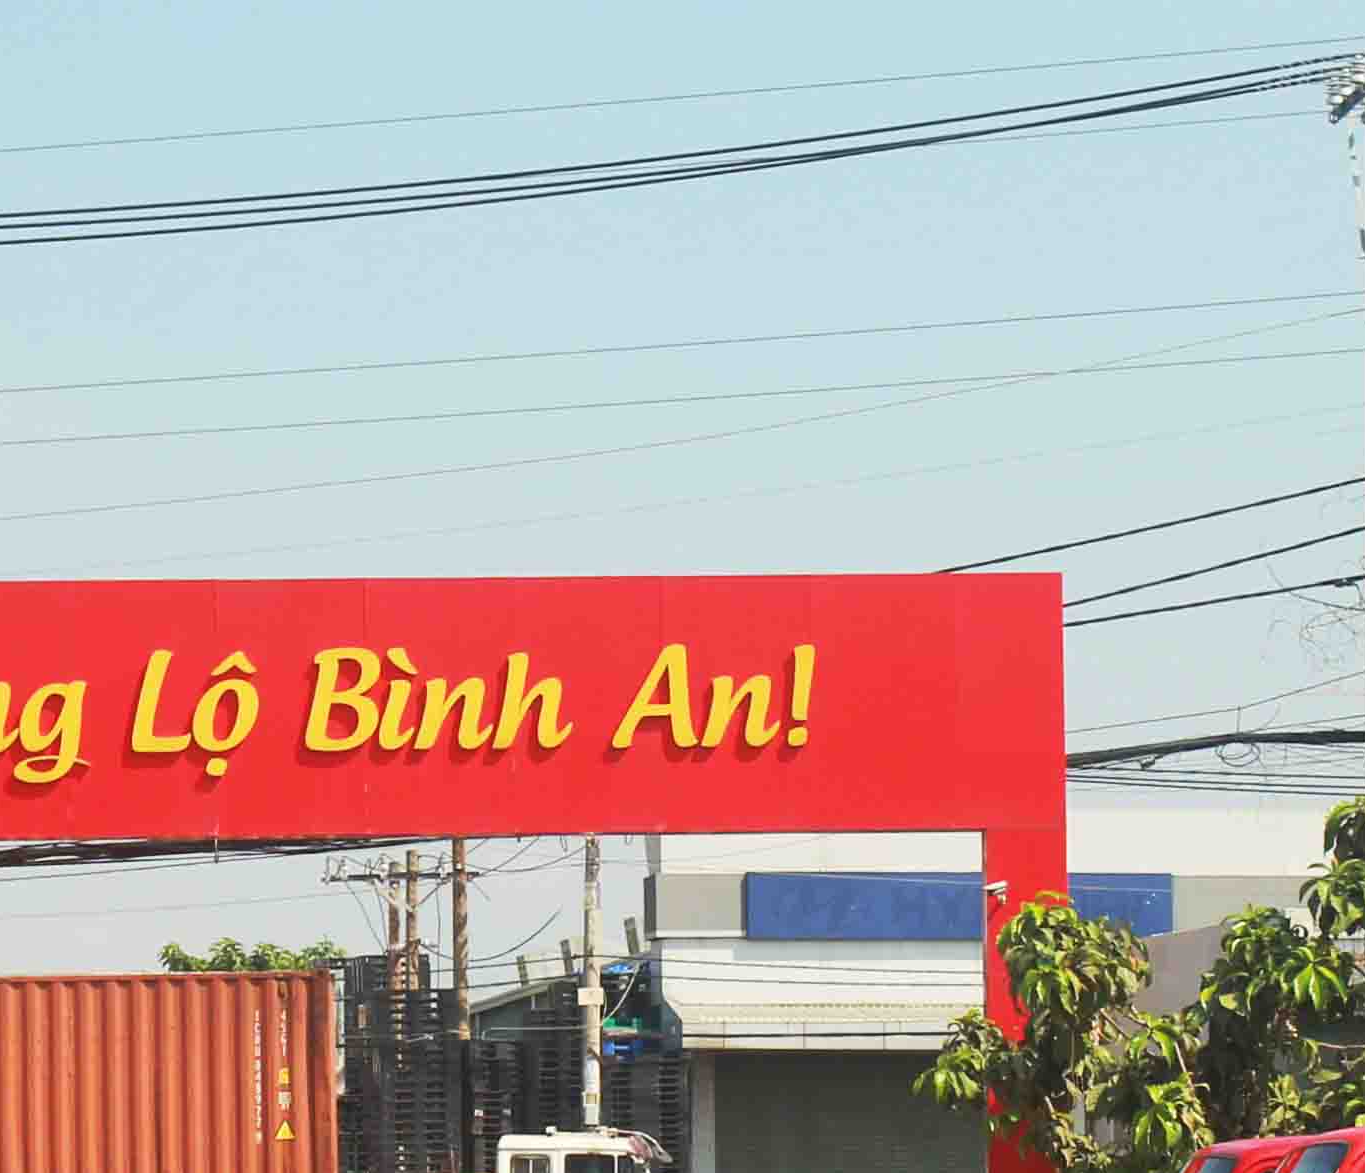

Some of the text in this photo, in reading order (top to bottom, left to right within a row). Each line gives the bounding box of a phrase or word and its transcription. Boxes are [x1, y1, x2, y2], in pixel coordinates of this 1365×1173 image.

[130, 648, 260, 777] Lộ
[303, 646, 573, 753] Bình
[611, 643, 817, 749] An!
